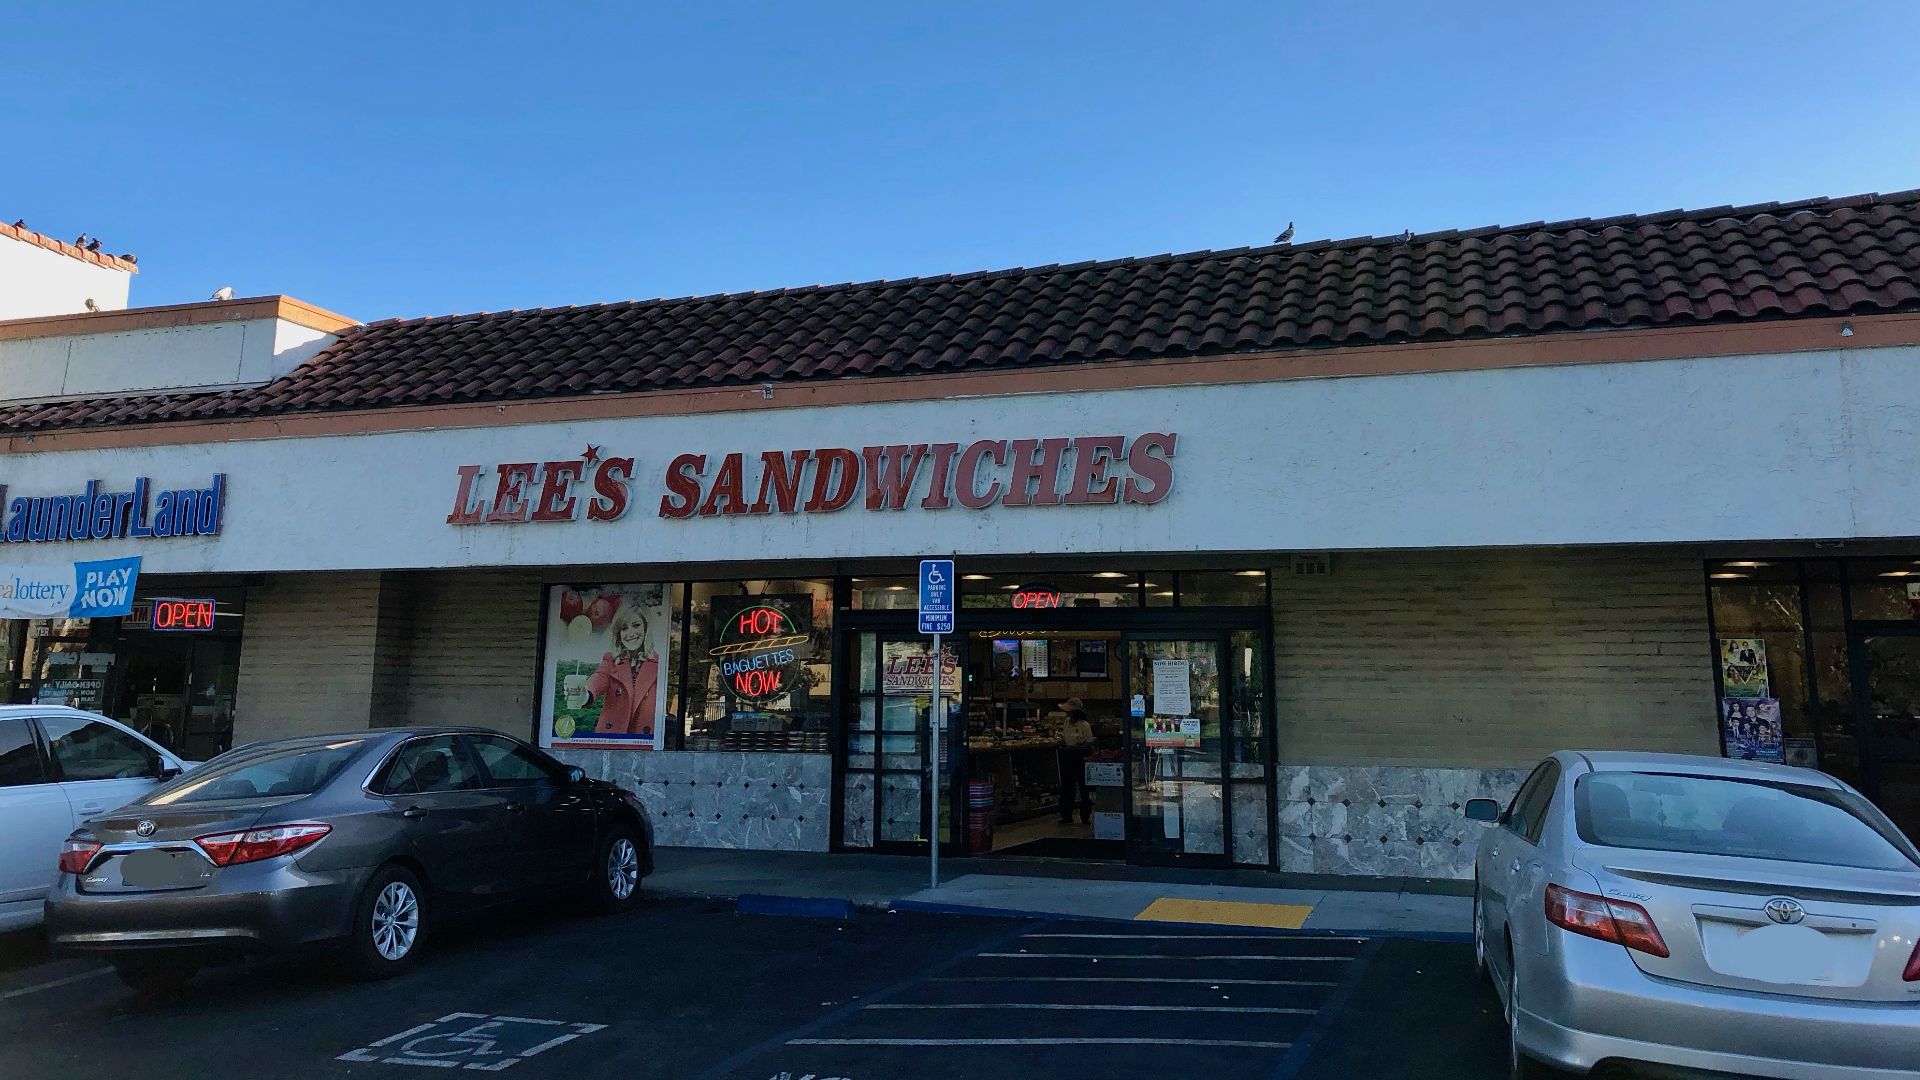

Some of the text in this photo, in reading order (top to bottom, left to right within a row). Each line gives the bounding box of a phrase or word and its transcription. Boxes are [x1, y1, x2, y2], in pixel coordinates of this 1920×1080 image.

[658, 432, 1178, 519] SANDWICHES
[0, 473, 225, 542] aunderLand
[84, 567, 132, 589] PLAY
[80, 586, 128, 609] NOW
[1012, 591, 1060, 608] OPEN
[157, 602, 213, 628] OPEN
[738, 608, 783, 635] HOT
[936, 622, 951, 630] $250
[723, 648, 795, 676] BAGUETTES
[734, 670, 782, 697] NOW
[886, 675, 956, 687] SANDWICES
